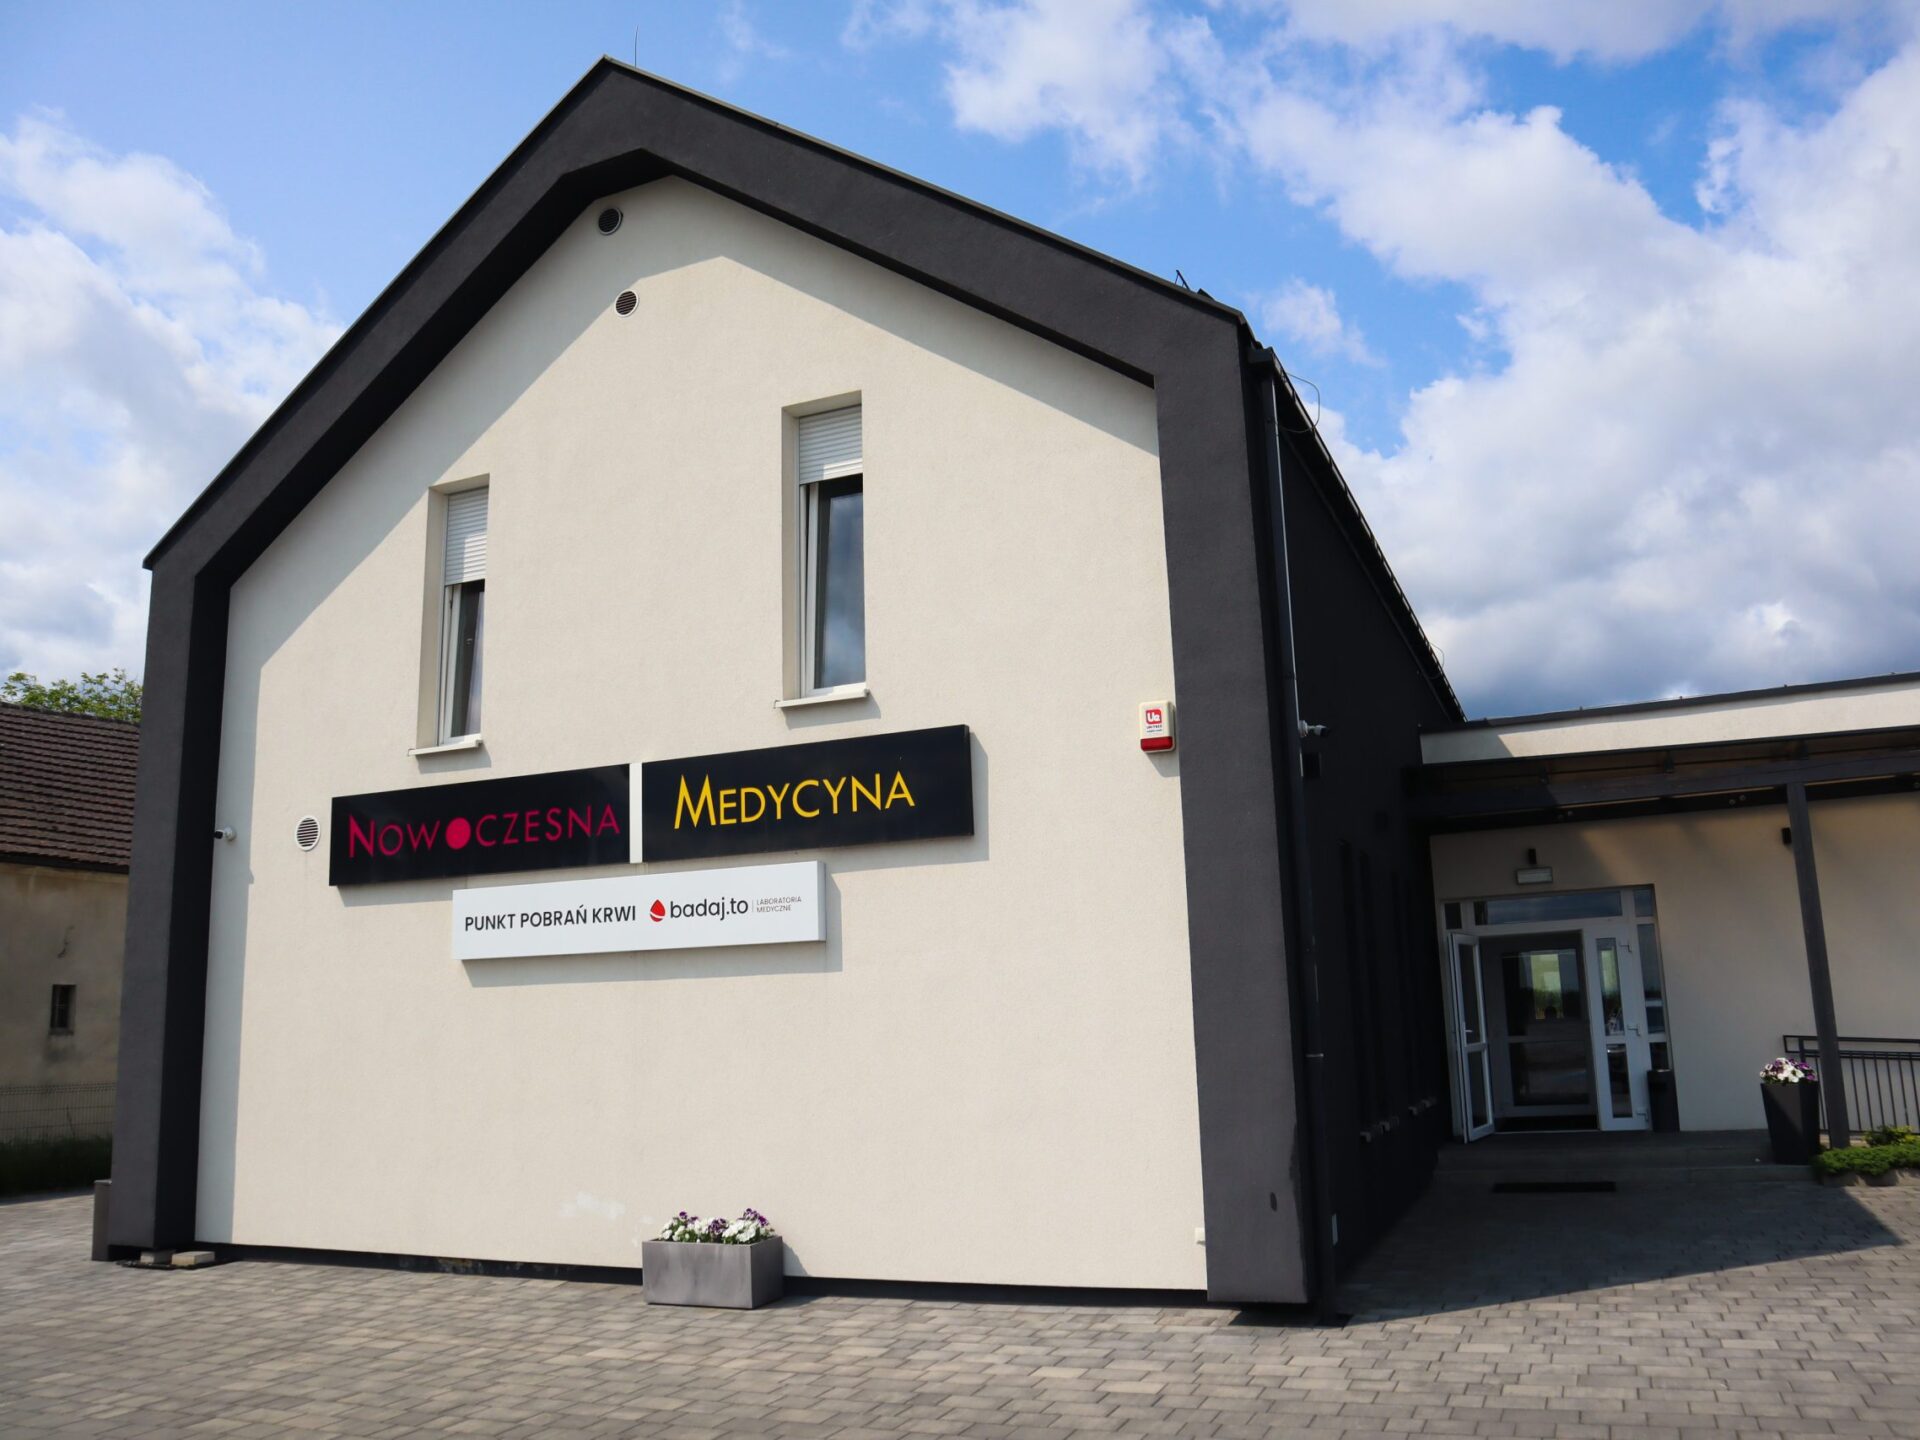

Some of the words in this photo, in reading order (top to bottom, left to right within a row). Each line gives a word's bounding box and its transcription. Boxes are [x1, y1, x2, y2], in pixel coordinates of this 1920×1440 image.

[673, 770, 915, 829] MEDYCYNA
[669, 896, 749, 921] badaj.to
[756, 896, 802, 906] LABORATORIA
[756, 904, 792, 913] MEDYCZNE
[465, 913, 516, 931] PUNKT
[520, 904, 588, 928] POBRAŃ
[592, 905, 636, 923] KRWI
